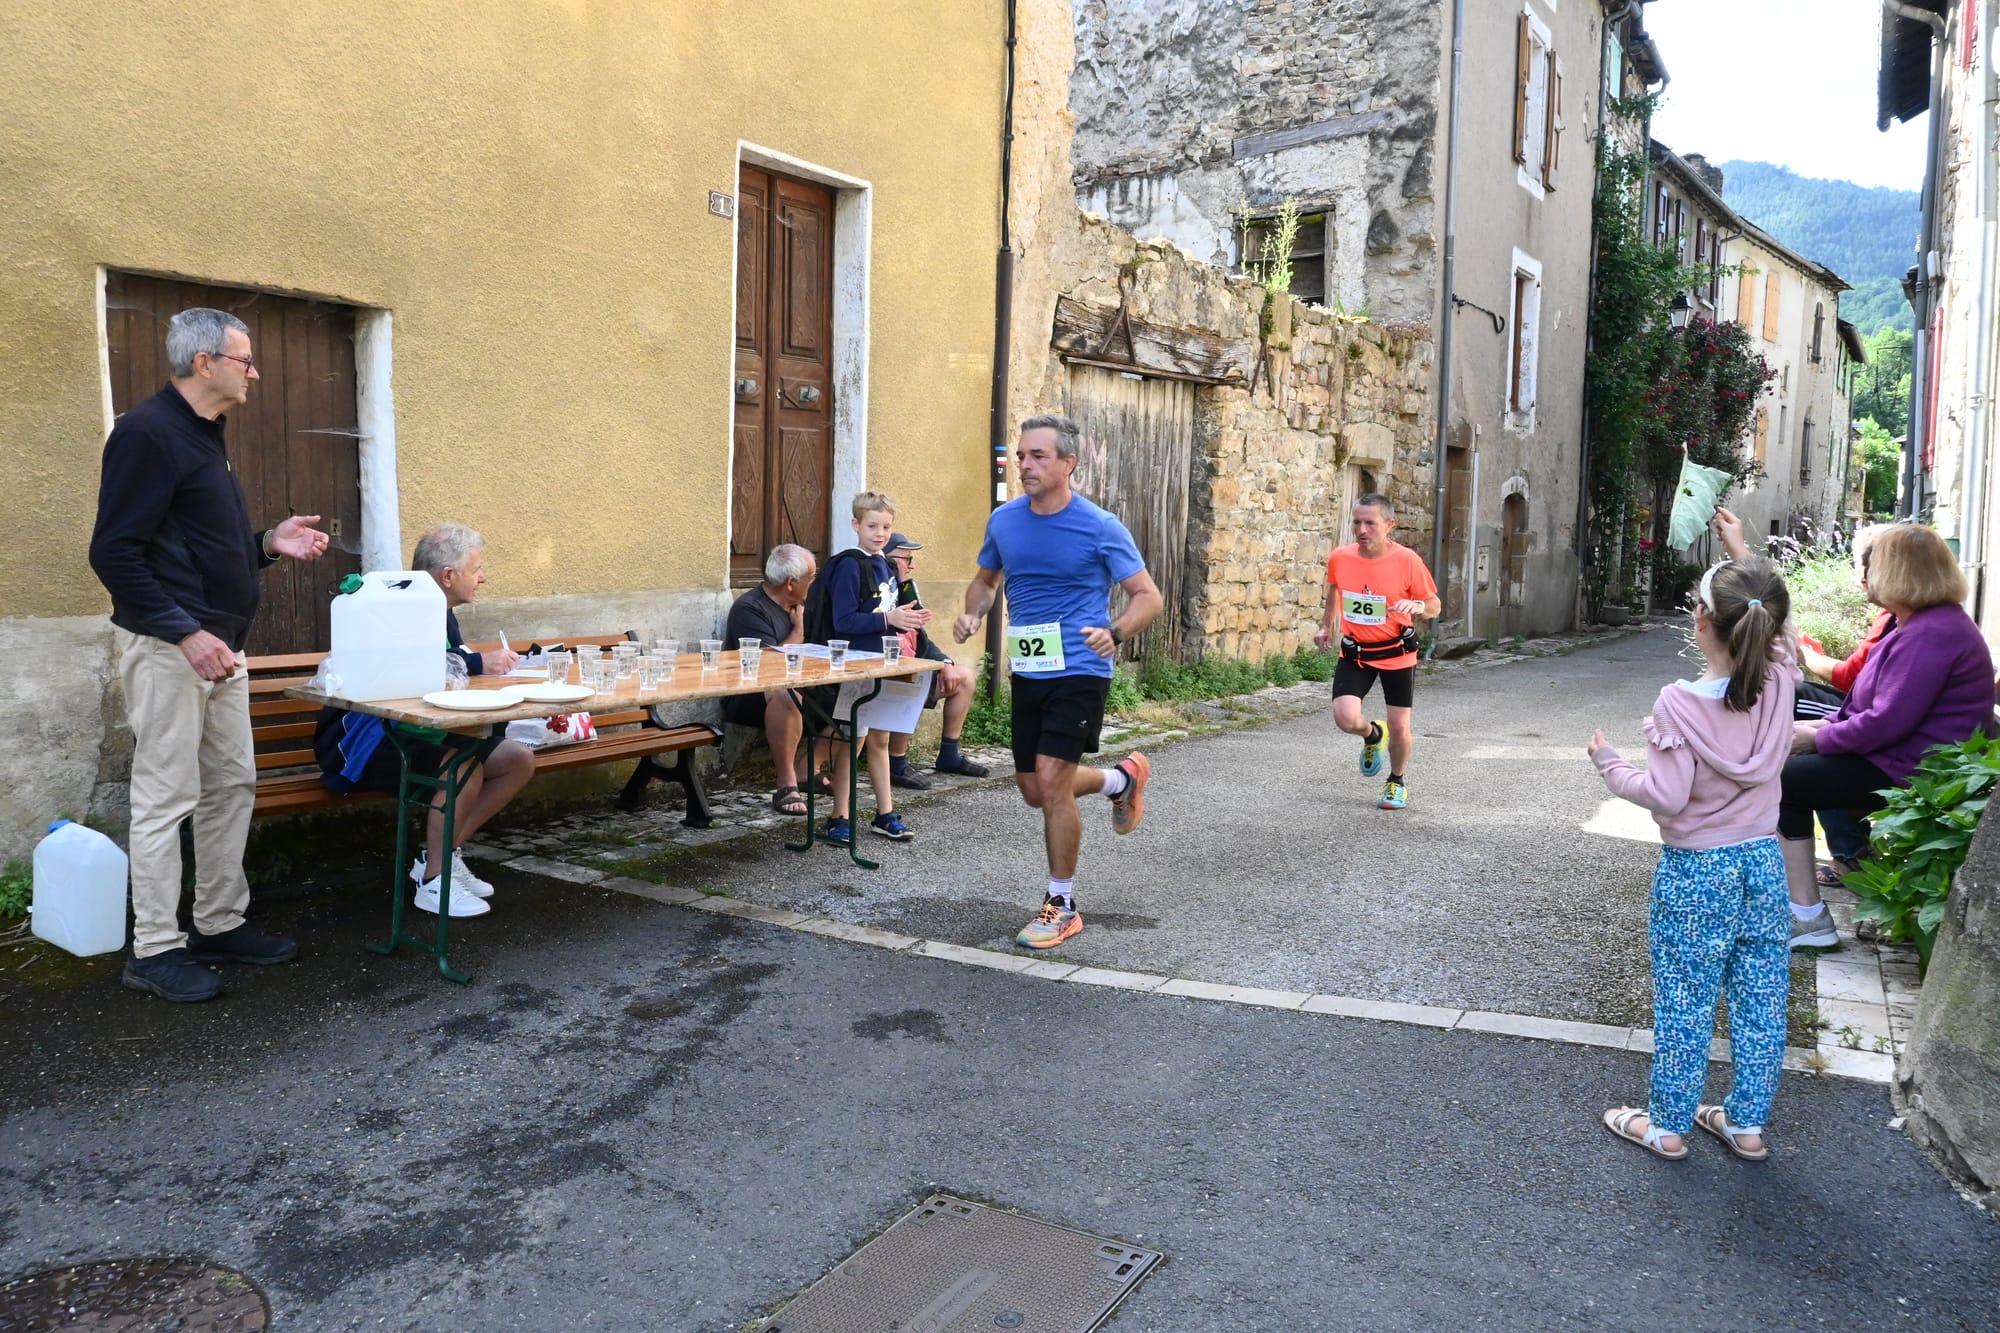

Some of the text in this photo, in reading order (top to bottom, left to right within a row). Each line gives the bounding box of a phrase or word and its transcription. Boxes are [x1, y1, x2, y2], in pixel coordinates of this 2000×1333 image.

[719, 197, 725, 212] 1
[1352, 601, 1373, 615] 26
[1018, 638, 1046, 657] 92
